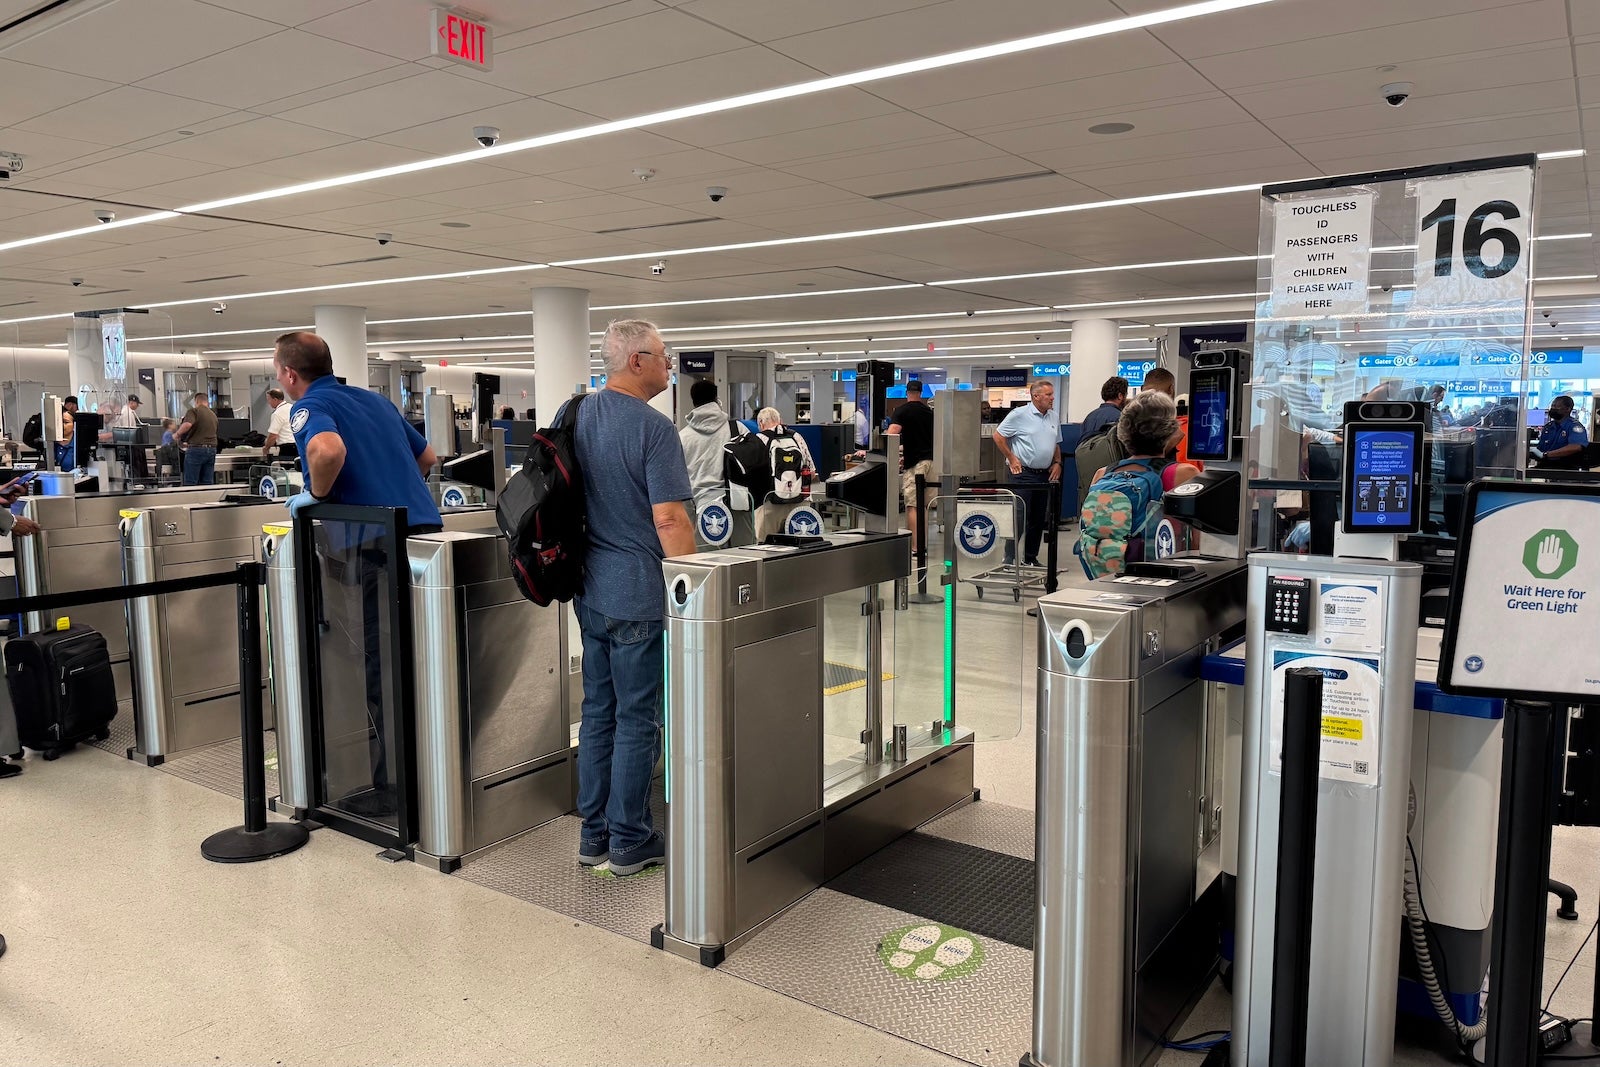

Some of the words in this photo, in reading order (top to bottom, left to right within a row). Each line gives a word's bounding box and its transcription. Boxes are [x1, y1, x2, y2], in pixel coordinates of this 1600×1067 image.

[447, 14, 486, 65] EXIT
[1292, 202, 1357, 216] TOUCHLESS
[1317, 220, 1328, 228] ID
[1287, 234, 1358, 248] PASSENGERS
[1421, 198, 1521, 279] 16
[1308, 252, 1334, 262] WITH
[1294, 266, 1348, 278] CHILDREN
[1287, 284, 1324, 294] PLEASE
[1327, 282, 1354, 292] WAIT
[1305, 300, 1332, 308] HERE
[1504, 584, 1532, 596] Wait
[1535, 586, 1564, 598] Here
[1567, 588, 1586, 599] for
[1507, 598, 1543, 610] Green
[1546, 601, 1578, 614] Light
[906, 933, 933, 945] STAND
[944, 945, 966, 956] HERE
